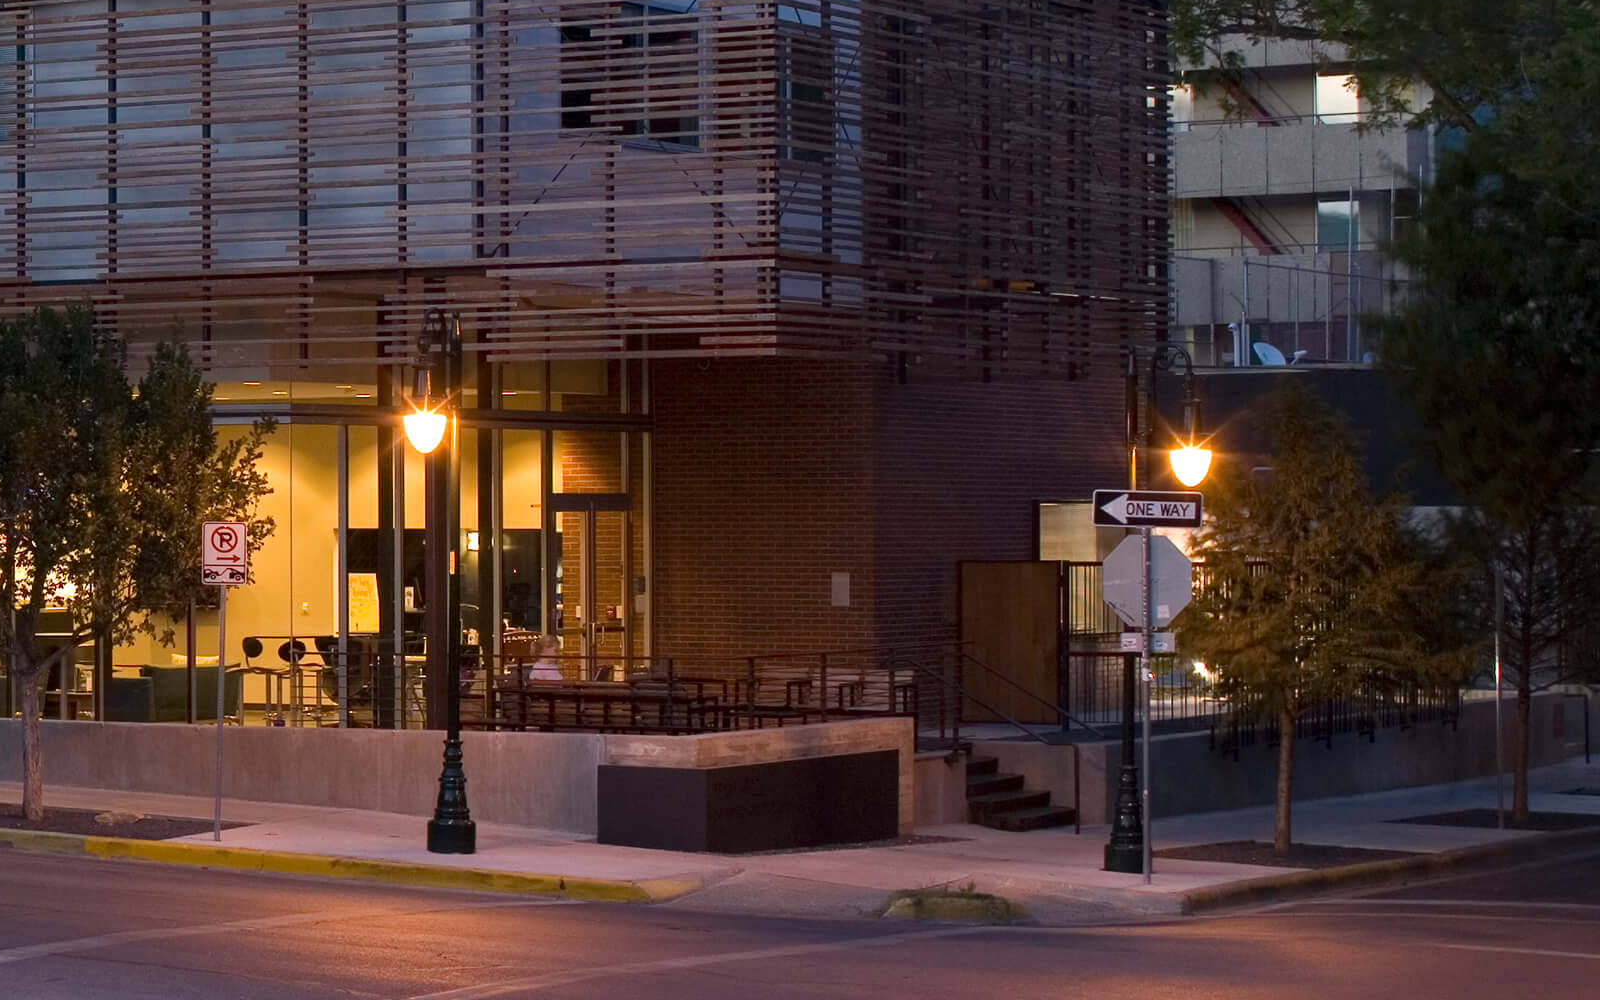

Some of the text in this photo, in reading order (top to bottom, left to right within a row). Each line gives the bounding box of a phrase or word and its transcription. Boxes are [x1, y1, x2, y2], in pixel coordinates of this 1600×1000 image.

[1126, 502, 1190, 517] ONE WAY
[219, 532, 233, 548] P
